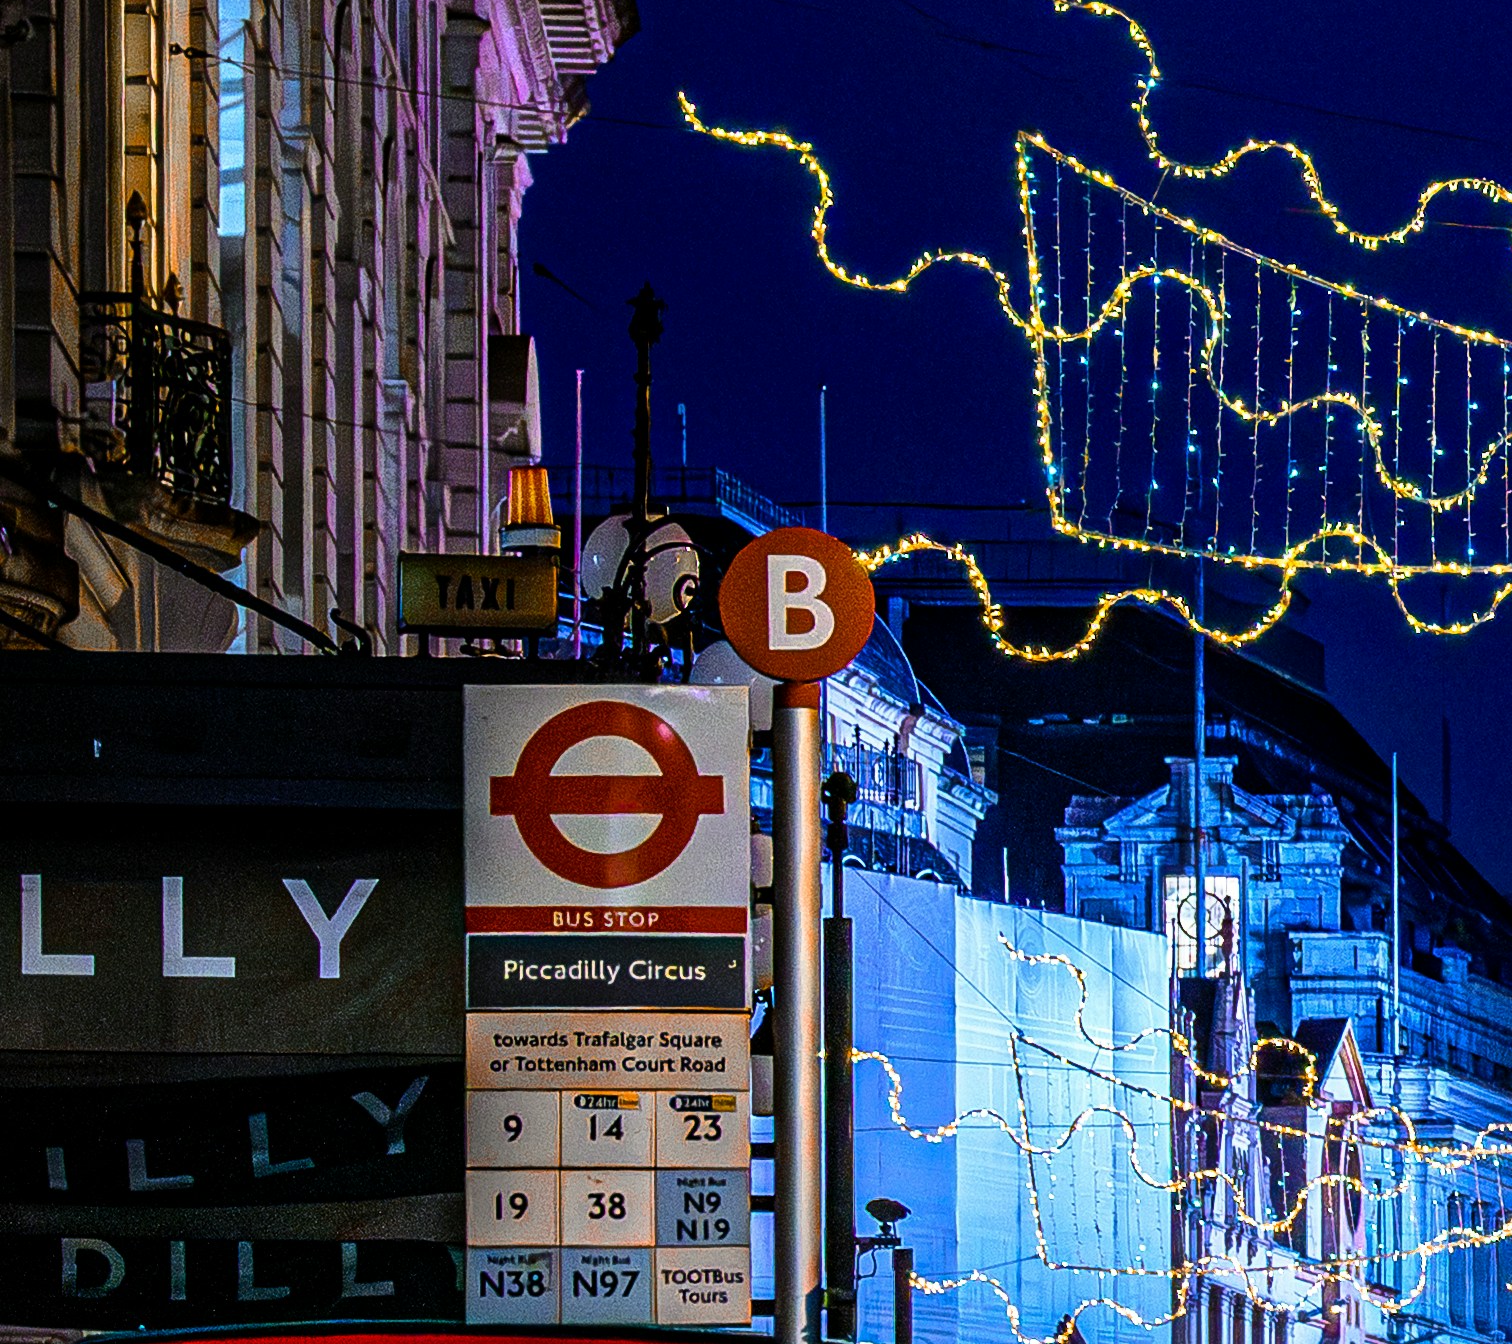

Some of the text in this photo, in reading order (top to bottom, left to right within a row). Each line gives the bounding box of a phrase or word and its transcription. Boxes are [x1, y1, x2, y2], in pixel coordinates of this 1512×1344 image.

[436, 575, 516, 611] TAXI
[766, 554, 836, 651] B
[553, 911, 660, 928] BUS STOP
[503, 959, 707, 985] Piccadilly Circus
[493, 1031, 723, 1051] towards Trafalgar Square
[490, 1057, 726, 1073] or Tottenham Court Road
[503, 1114, 523, 1142] 9
[588, 1114, 624, 1141] 14
[683, 1114, 722, 1141] 23
[495, 1192, 529, 1220] 19
[588, 1192, 627, 1220] 38
[683, 1192, 722, 1214] N9
[677, 1219, 730, 1241] N19
[479, 1271, 545, 1298] N38
[572, 1270, 640, 1298] N97
[661, 1269, 744, 1285] TOOTBus
[679, 1288, 728, 1304] Tours
